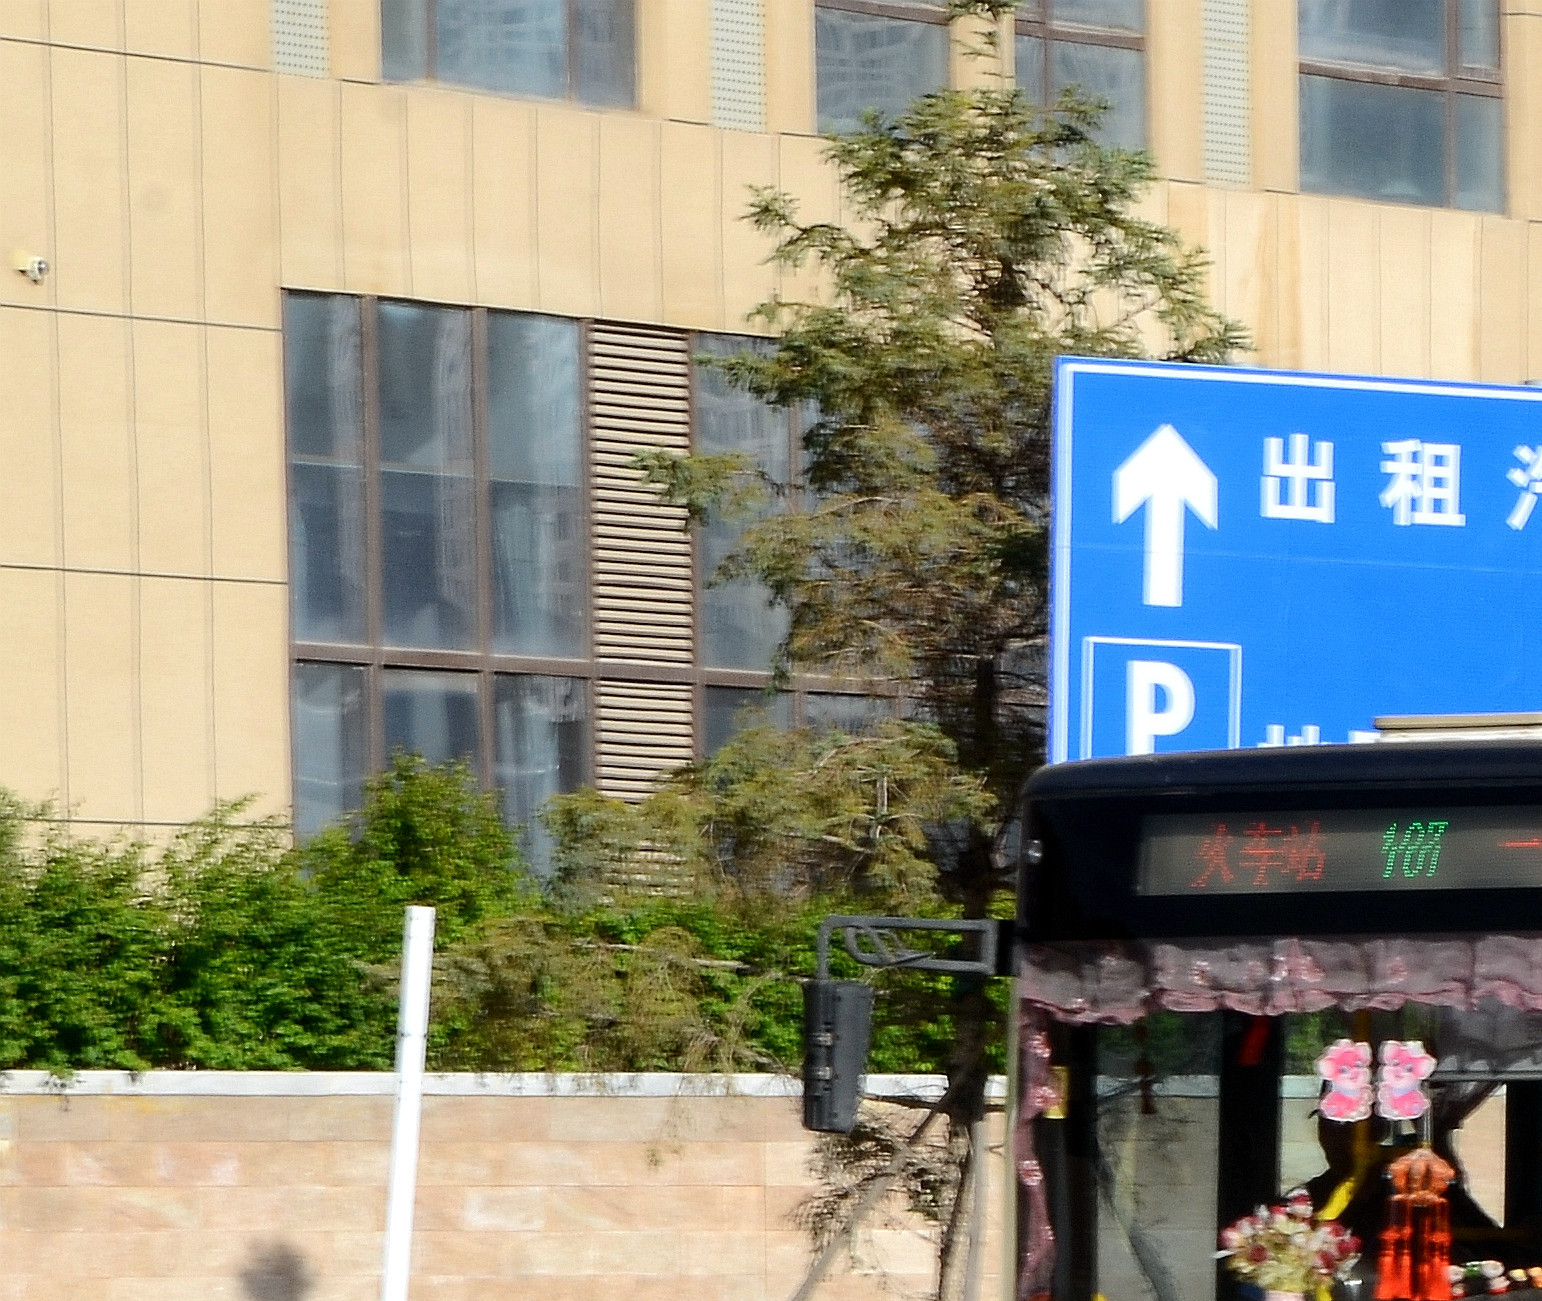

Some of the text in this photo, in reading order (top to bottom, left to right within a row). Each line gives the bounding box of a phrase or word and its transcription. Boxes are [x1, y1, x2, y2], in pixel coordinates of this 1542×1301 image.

[1125, 659, 1197, 756] P
[1190, 819, 1328, 889] 火车站
